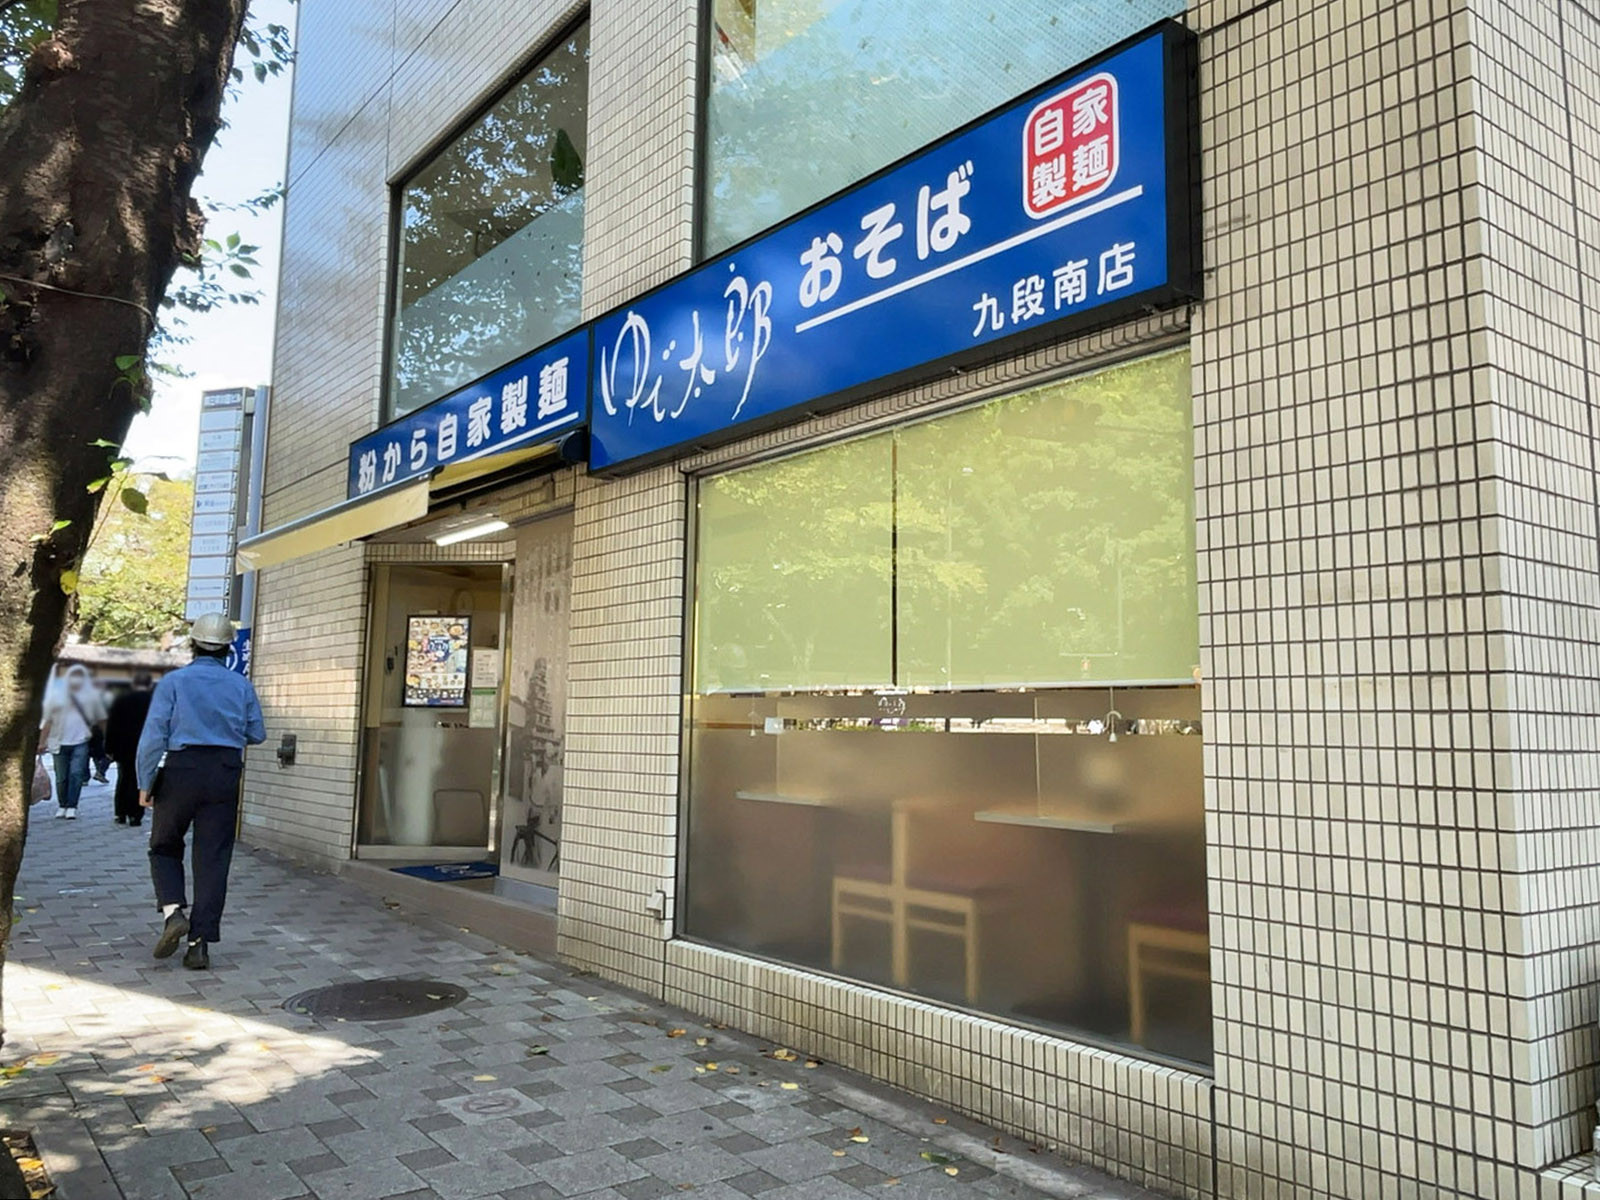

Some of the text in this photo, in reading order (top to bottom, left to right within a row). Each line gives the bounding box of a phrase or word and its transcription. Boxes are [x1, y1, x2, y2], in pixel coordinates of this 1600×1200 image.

[1034, 84, 1109, 157] 自家
[1032, 134, 1109, 208] 製麺
[799, 160, 976, 308] おそば
[971, 242, 1137, 338] 九段南店
[357, 357, 570, 495] 粉から自家製麺
